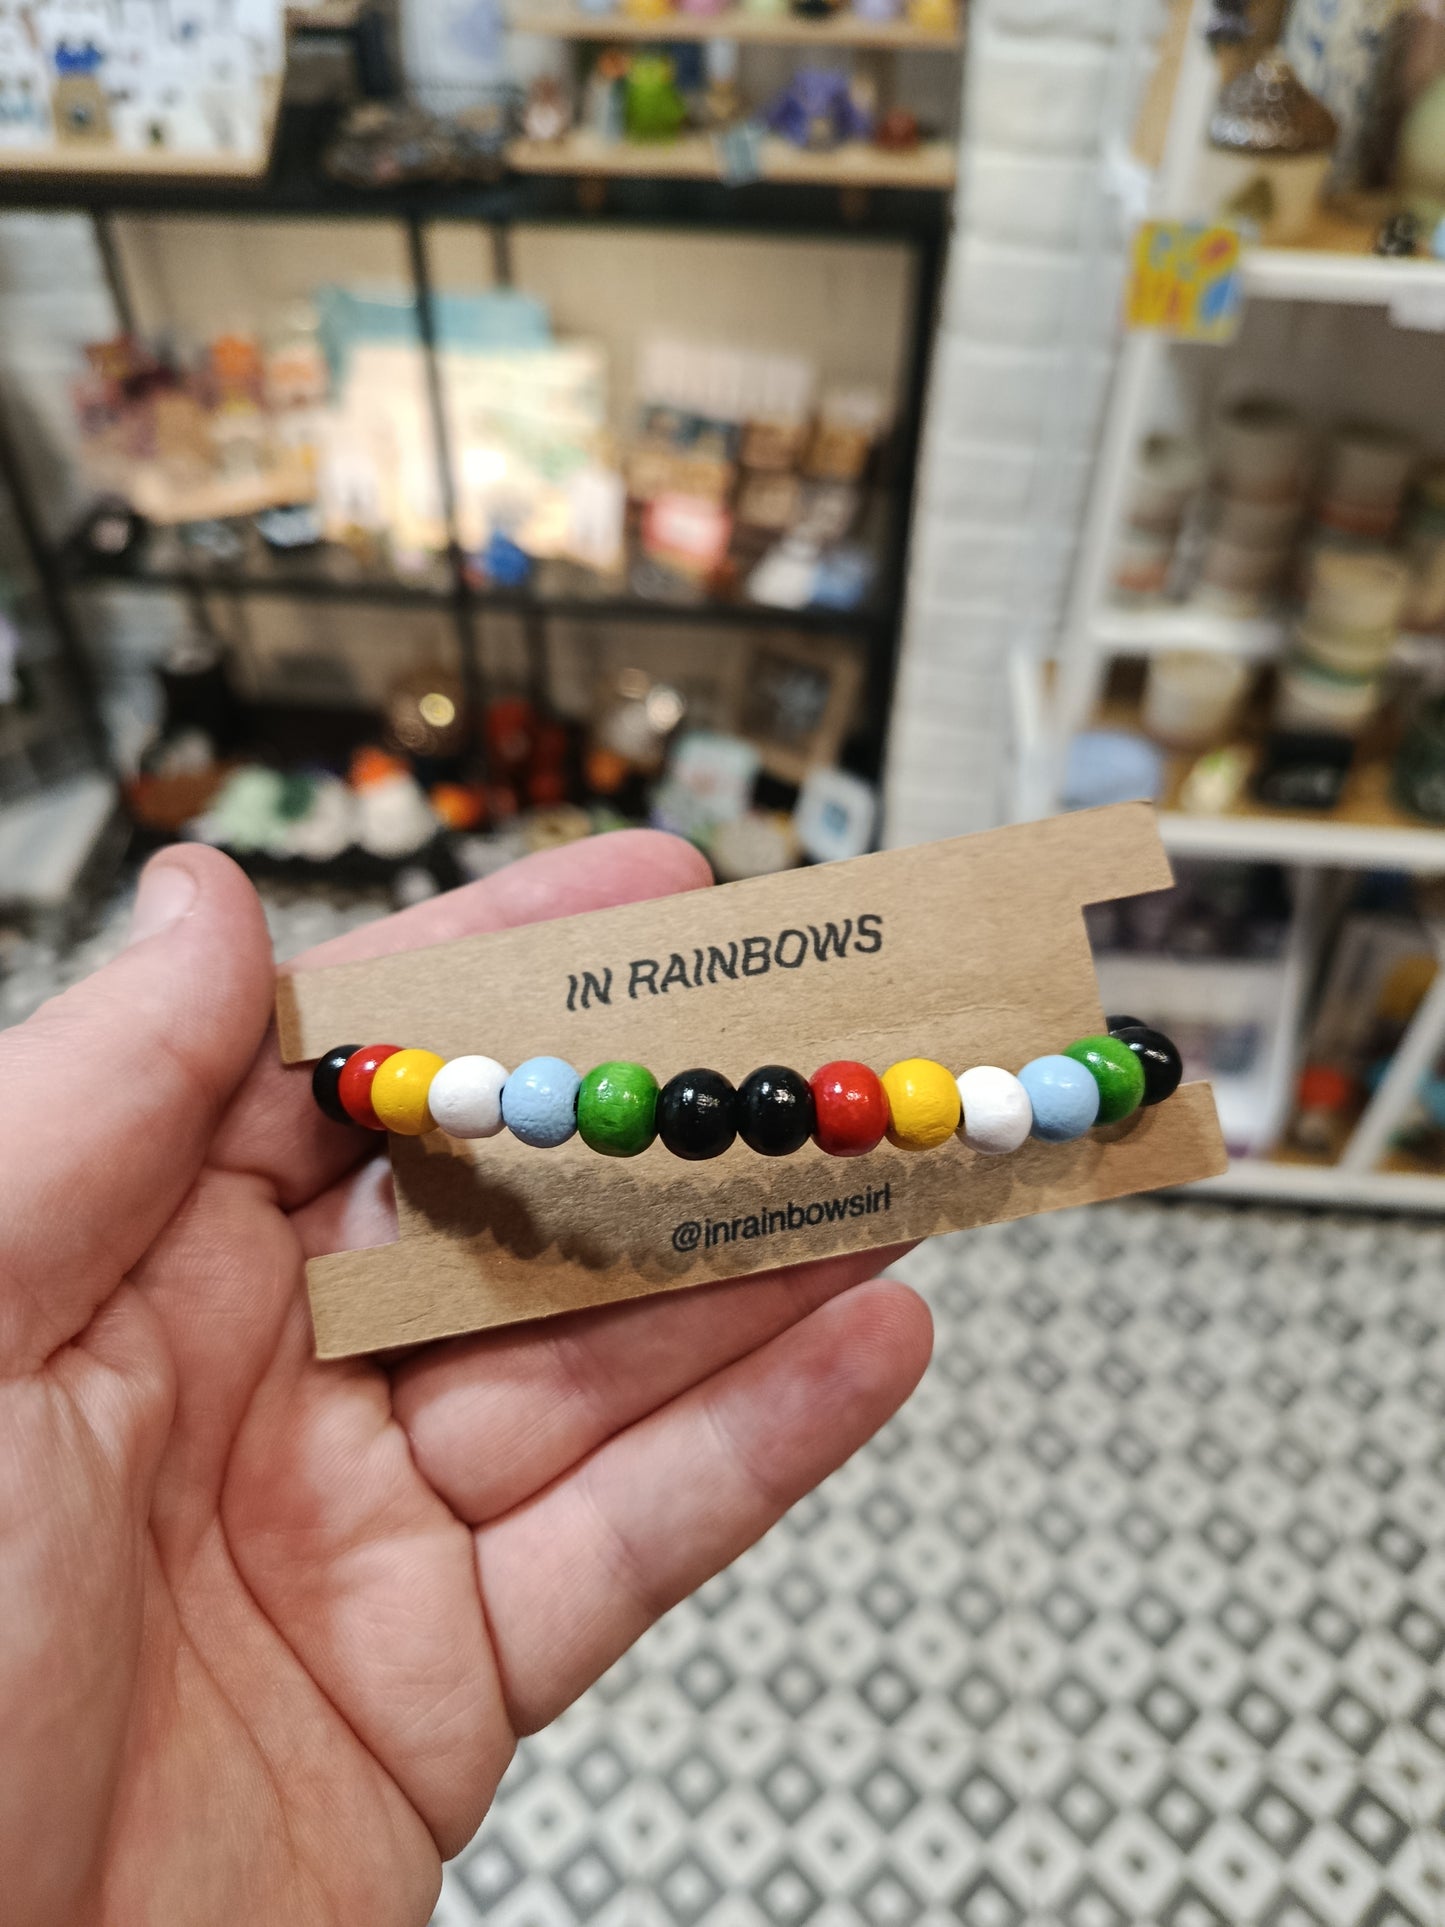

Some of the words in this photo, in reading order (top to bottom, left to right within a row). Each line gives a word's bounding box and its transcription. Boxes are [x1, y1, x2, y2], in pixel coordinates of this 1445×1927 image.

[566, 967, 612, 1011] IN
[628, 914, 883, 999] RAINBOWS
[672, 1183, 892, 1252] @inrainbowsirl
